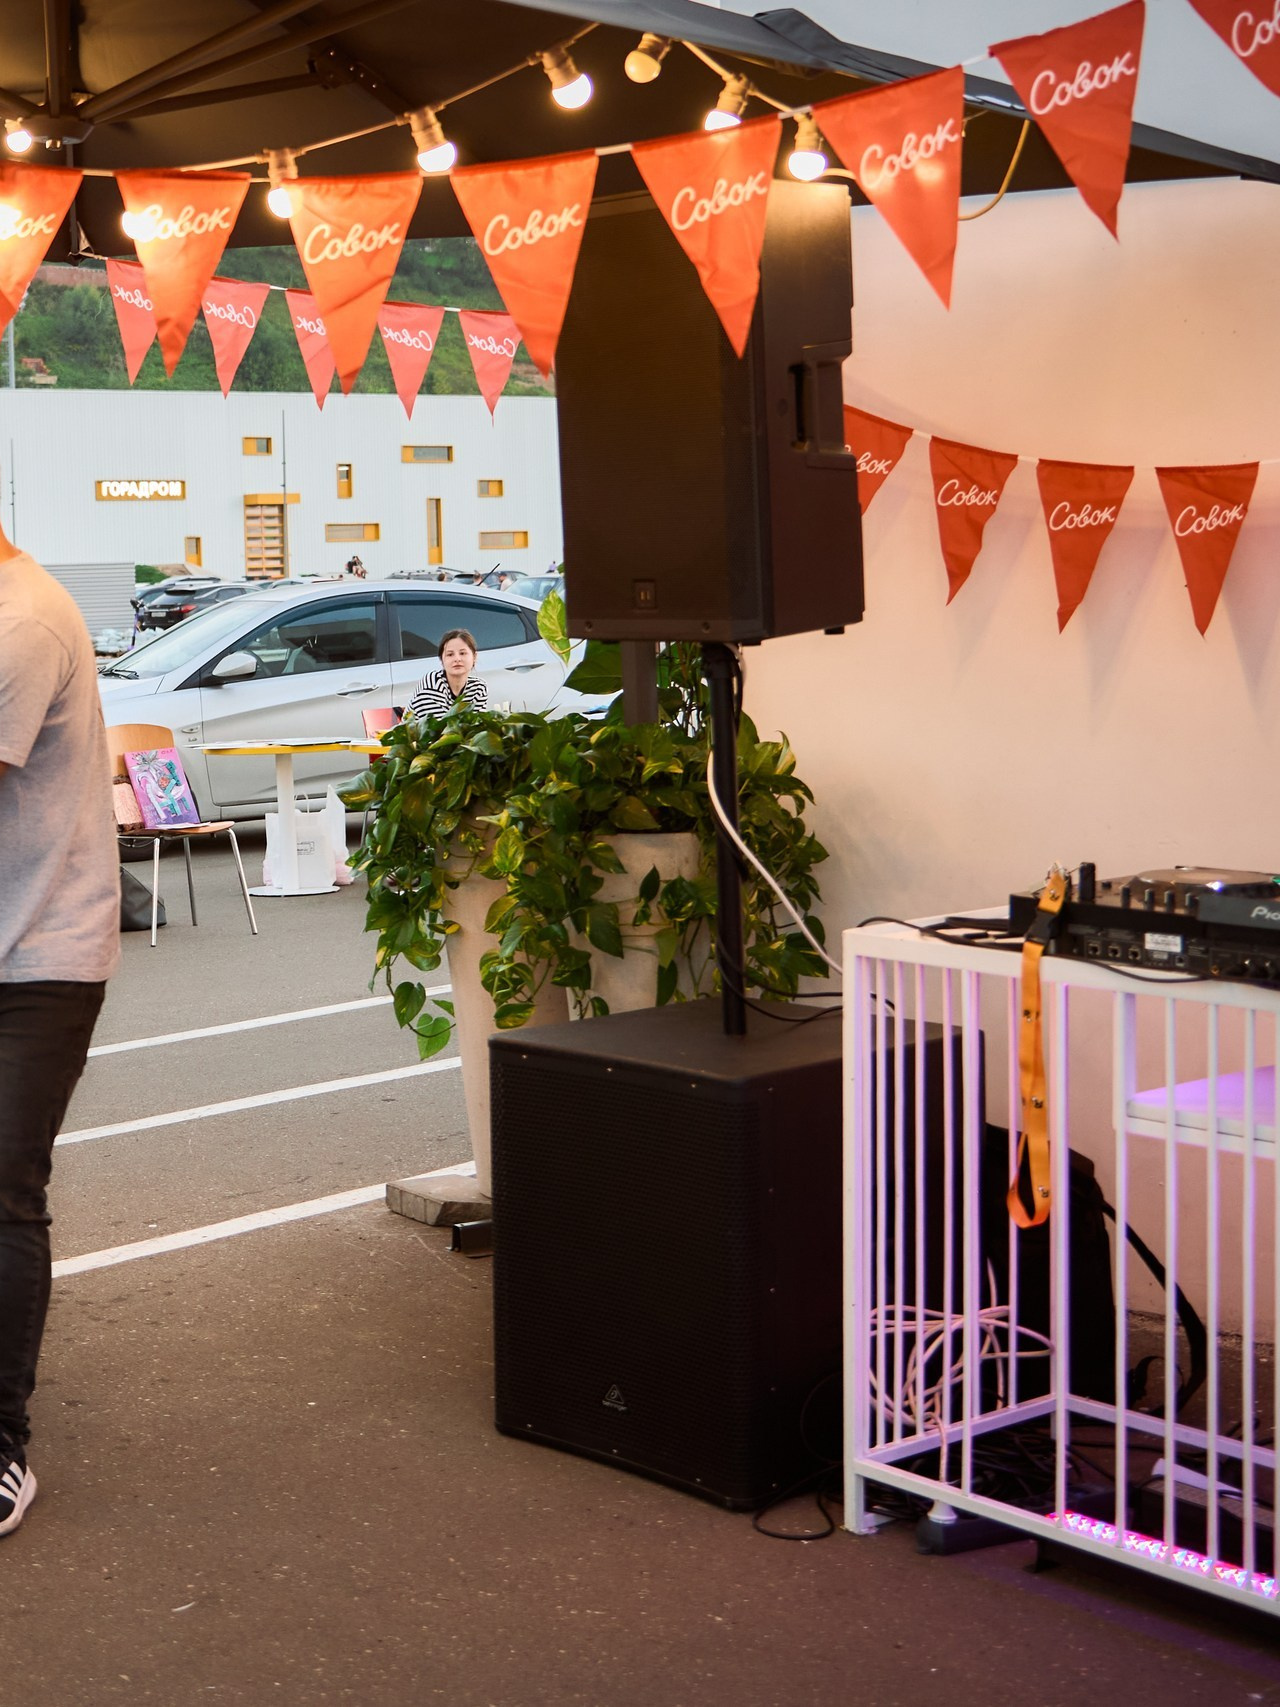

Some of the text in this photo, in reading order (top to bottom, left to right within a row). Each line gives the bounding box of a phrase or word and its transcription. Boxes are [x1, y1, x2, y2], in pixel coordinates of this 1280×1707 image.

[1030, 51, 1136, 115] Совок
[860, 118, 958, 189] Совок
[671, 171, 767, 231] Совок
[304, 222, 401, 265] Совок
[484, 203, 582, 256] Совок
[844, 444, 892, 475] вок
[101, 481, 182, 499] ГОРАДРОМ
[937, 479, 997, 507] Совок
[1049, 501, 1116, 531] Совок
[1175, 503, 1244, 537] Совок
